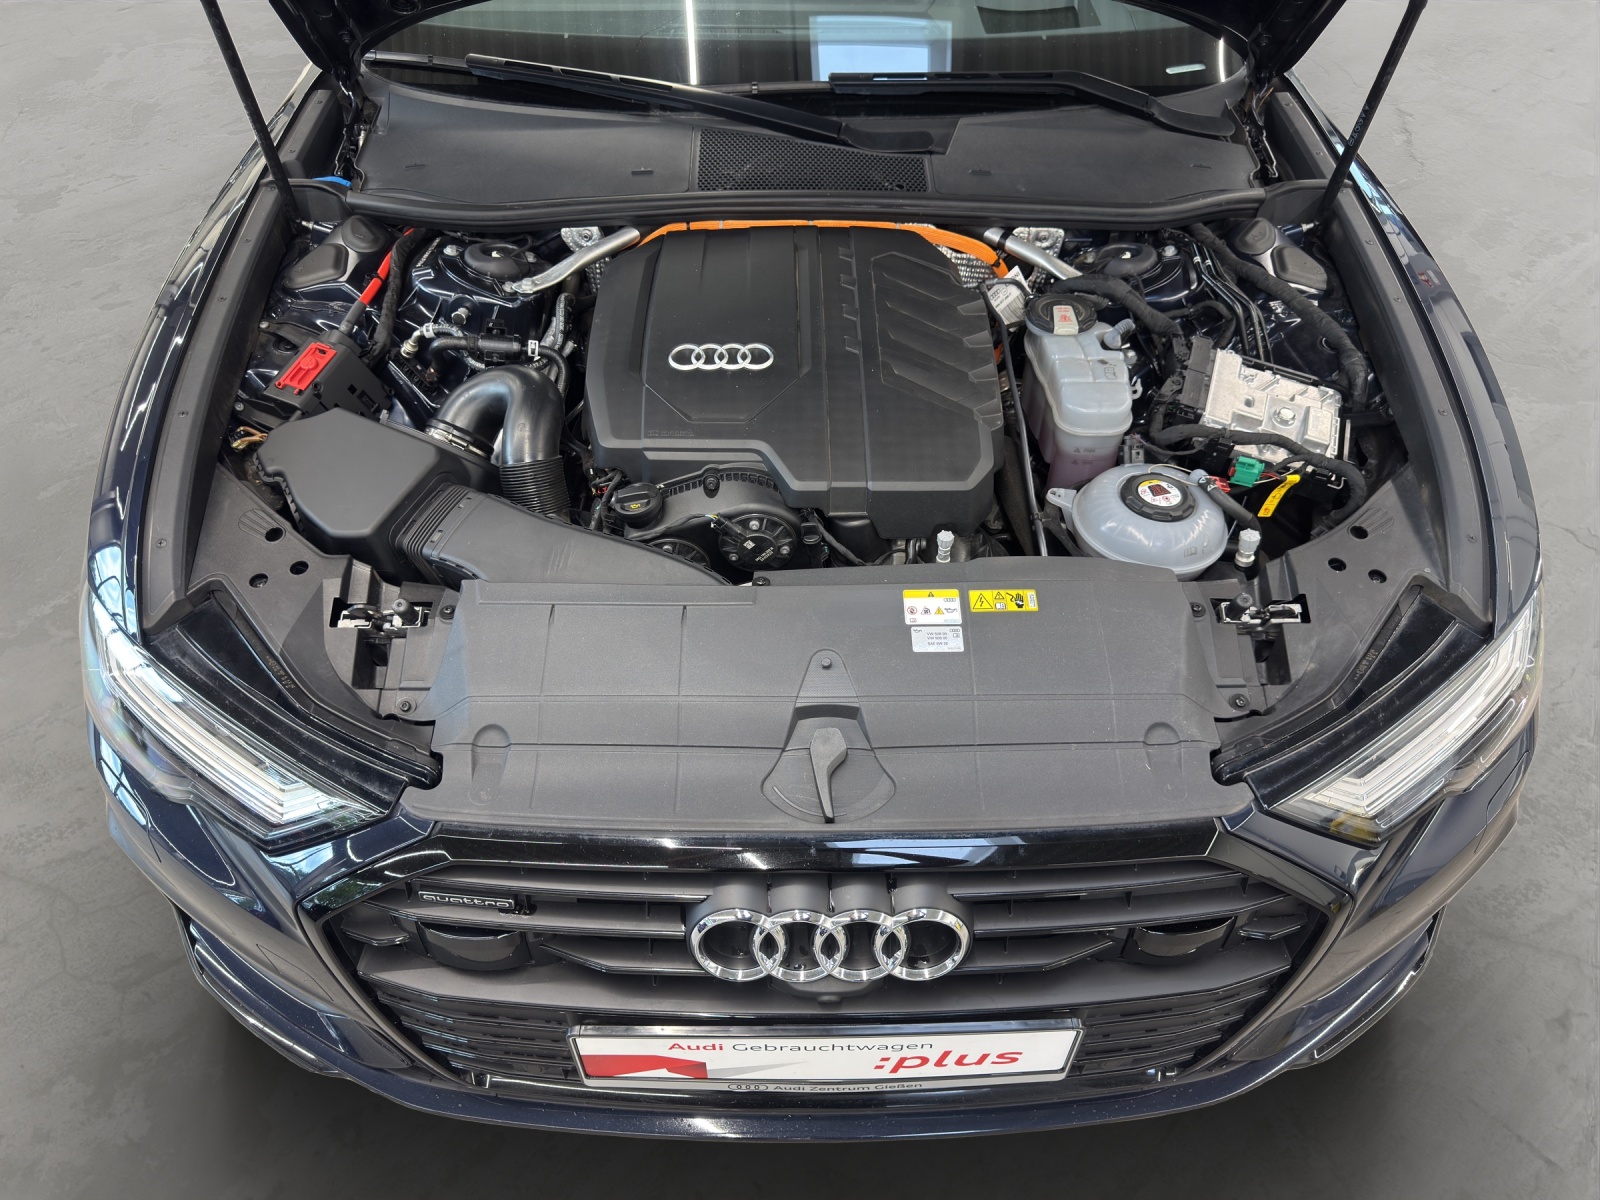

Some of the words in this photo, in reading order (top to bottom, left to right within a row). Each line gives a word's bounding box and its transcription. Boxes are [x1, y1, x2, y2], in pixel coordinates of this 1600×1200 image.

[423, 895, 509, 907] quattro
[668, 1043, 724, 1051] Audi
[732, 1043, 933, 1053] Gebrauchtwagen
[874, 1050, 1024, 1074] :plus
